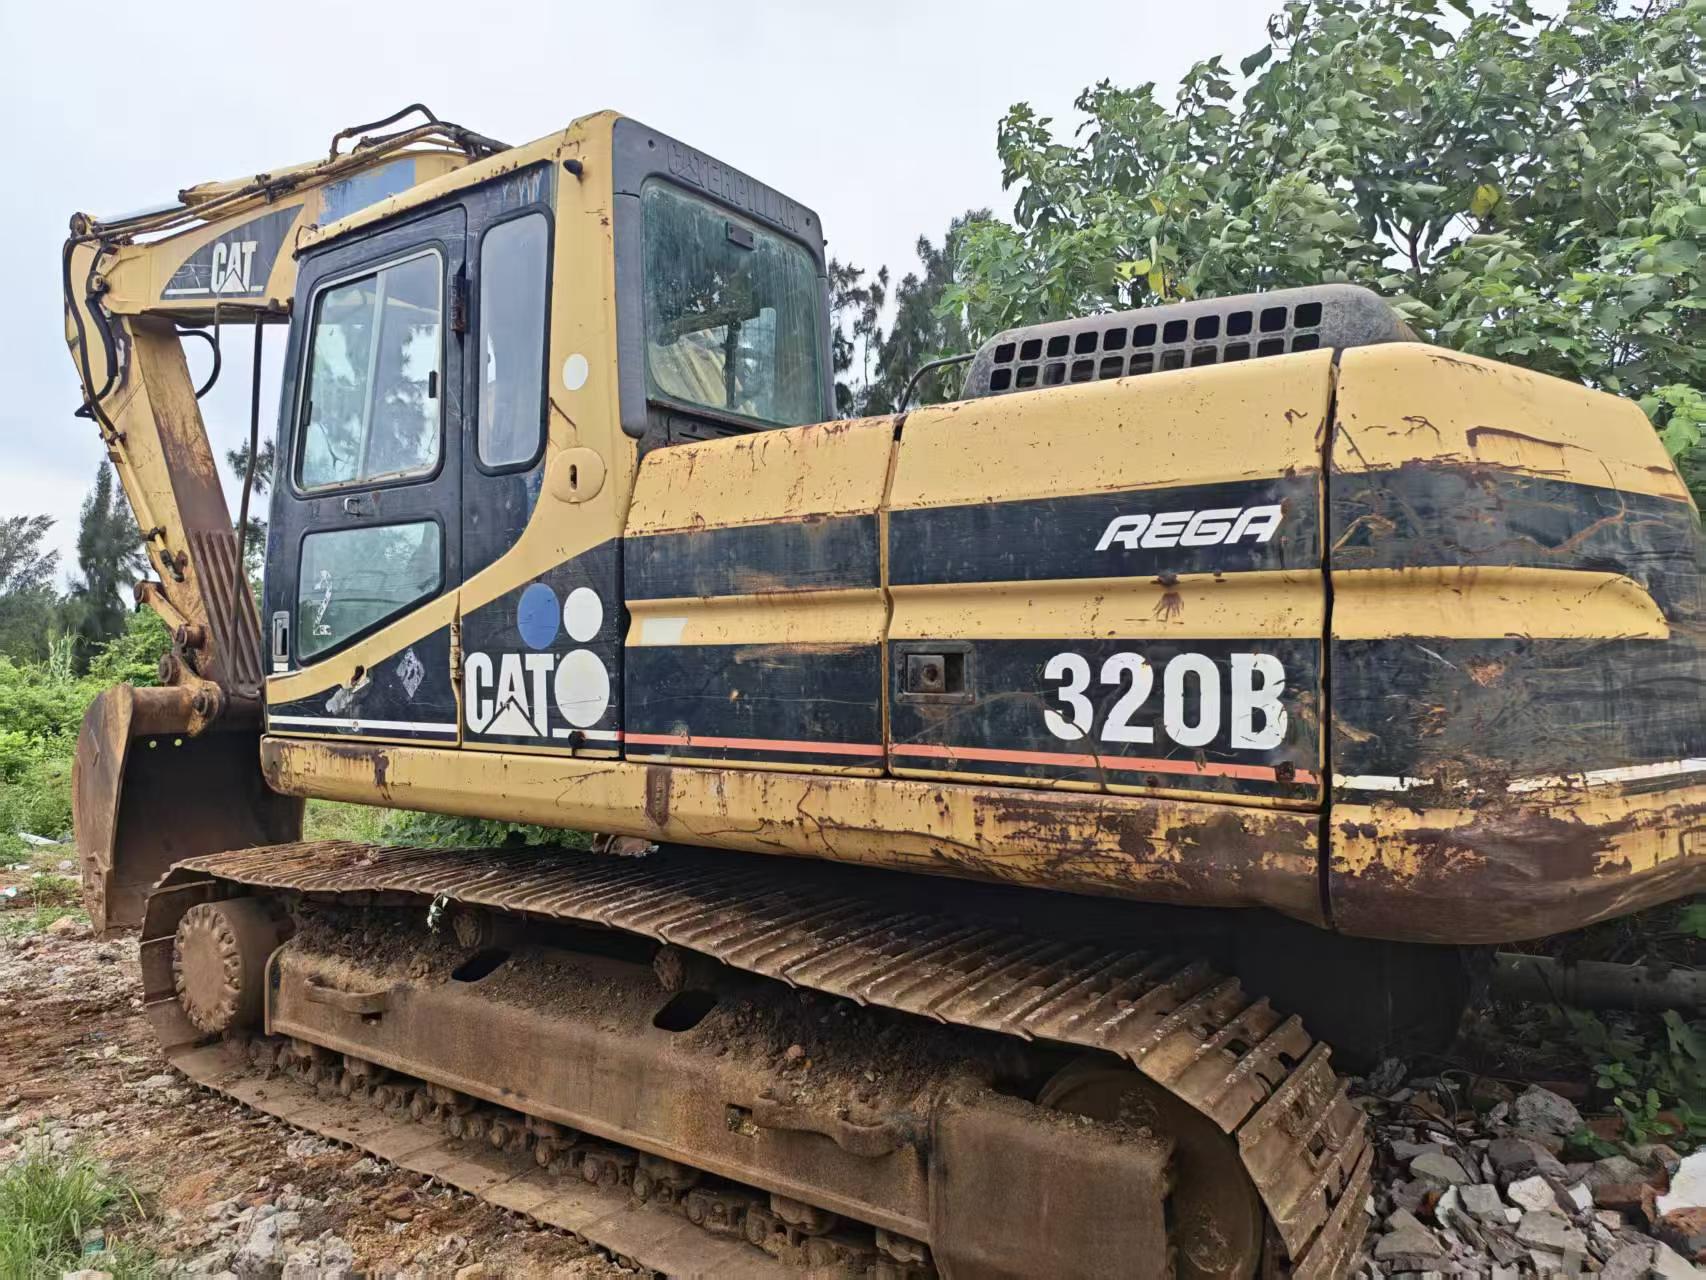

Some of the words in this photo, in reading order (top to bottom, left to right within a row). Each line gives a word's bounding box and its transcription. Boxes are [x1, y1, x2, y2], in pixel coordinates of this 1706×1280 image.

[210, 240, 258, 294] CAT
[1094, 504, 1284, 551] REGA
[464, 651, 555, 737] CAT
[1043, 652, 1288, 750] 320B
